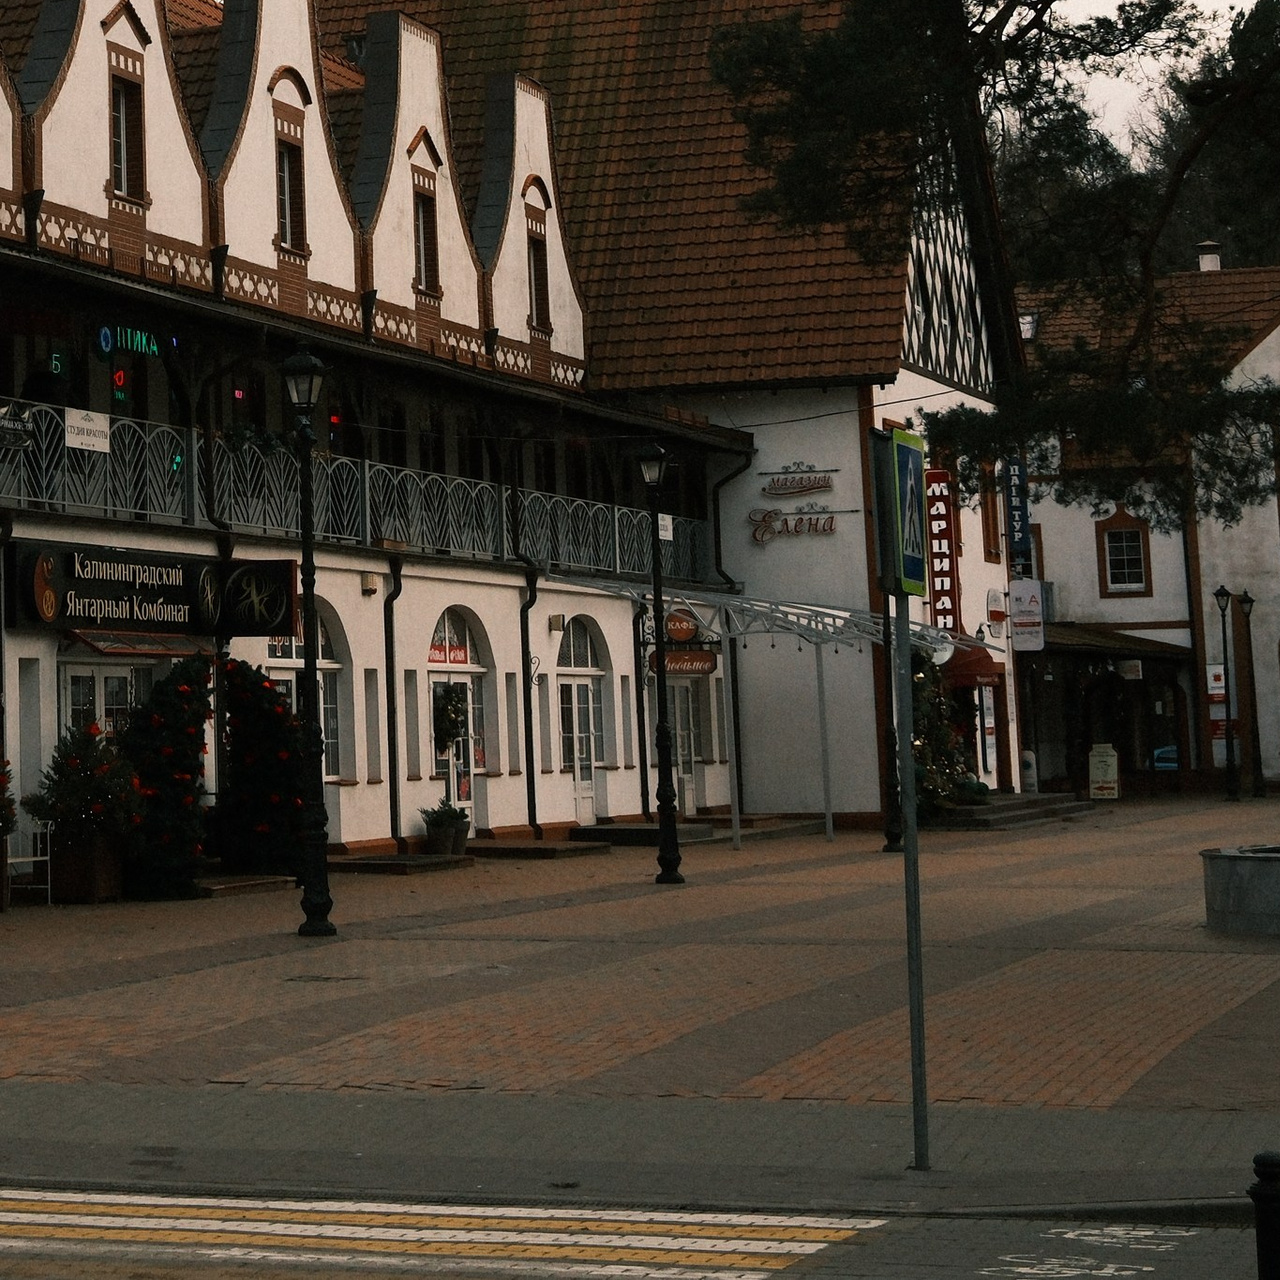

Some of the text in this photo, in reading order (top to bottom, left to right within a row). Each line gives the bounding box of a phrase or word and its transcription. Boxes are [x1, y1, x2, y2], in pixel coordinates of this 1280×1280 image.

[66, 425, 109, 440] СТУДИЯ КРАСОТЫ
[769, 475, 832, 488] магазин
[748, 508, 836, 543] Елена
[74, 552, 183, 590] Калининградский
[926, 482, 954, 629] МАРЦИПАН
[66, 590, 190, 625] Янтарный Комбинат
